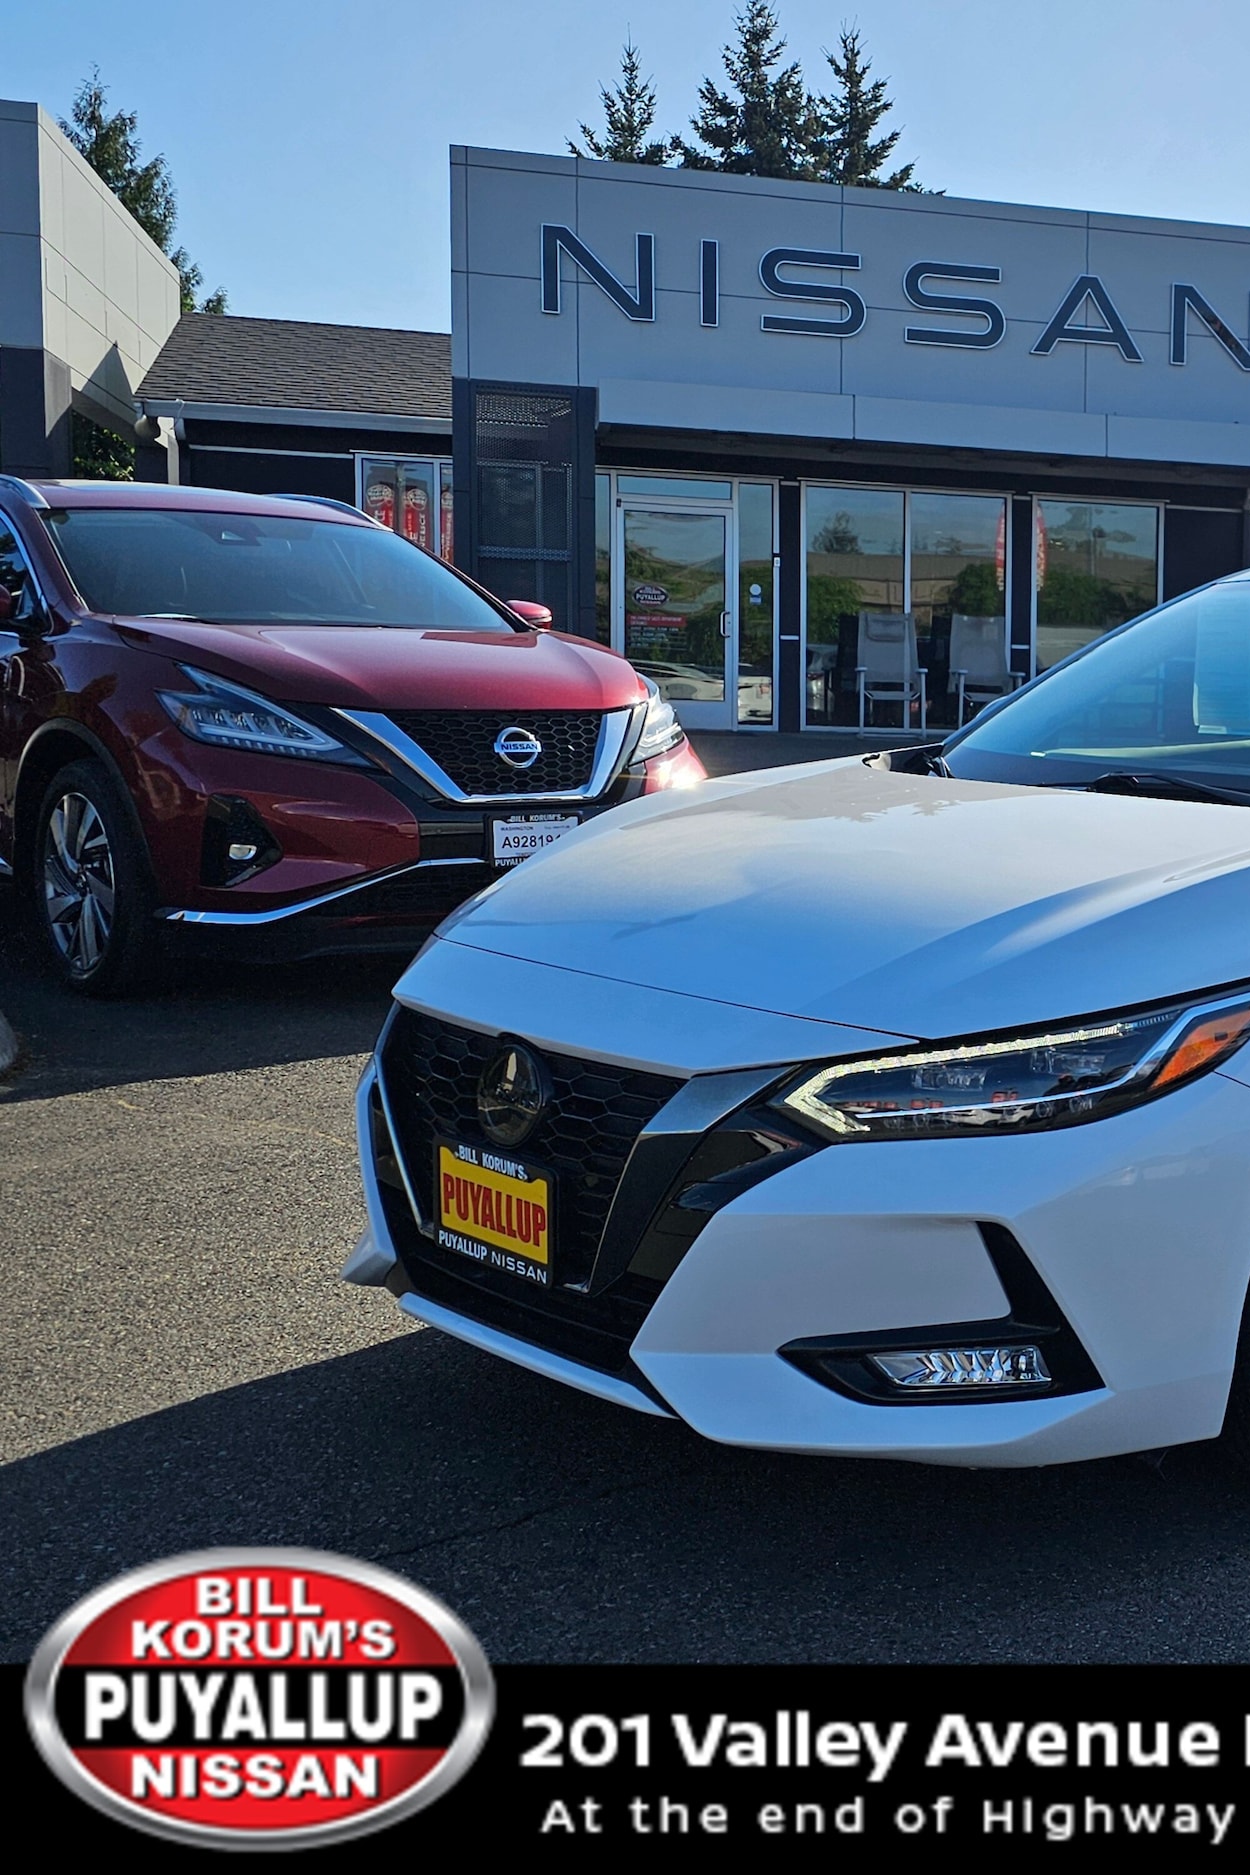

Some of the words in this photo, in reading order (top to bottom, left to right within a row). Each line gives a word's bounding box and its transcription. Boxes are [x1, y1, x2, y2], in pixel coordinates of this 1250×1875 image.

[501, 743, 538, 751] NISSAN
[501, 834, 561, 849] A92819
[458, 1145, 479, 1164] BILL
[482, 1152, 525, 1179] KORUM'S
[443, 1172, 546, 1248] PUYALLUP
[438, 1230, 487, 1261] PUYALLUP
[491, 1251, 547, 1285] NISSAN
